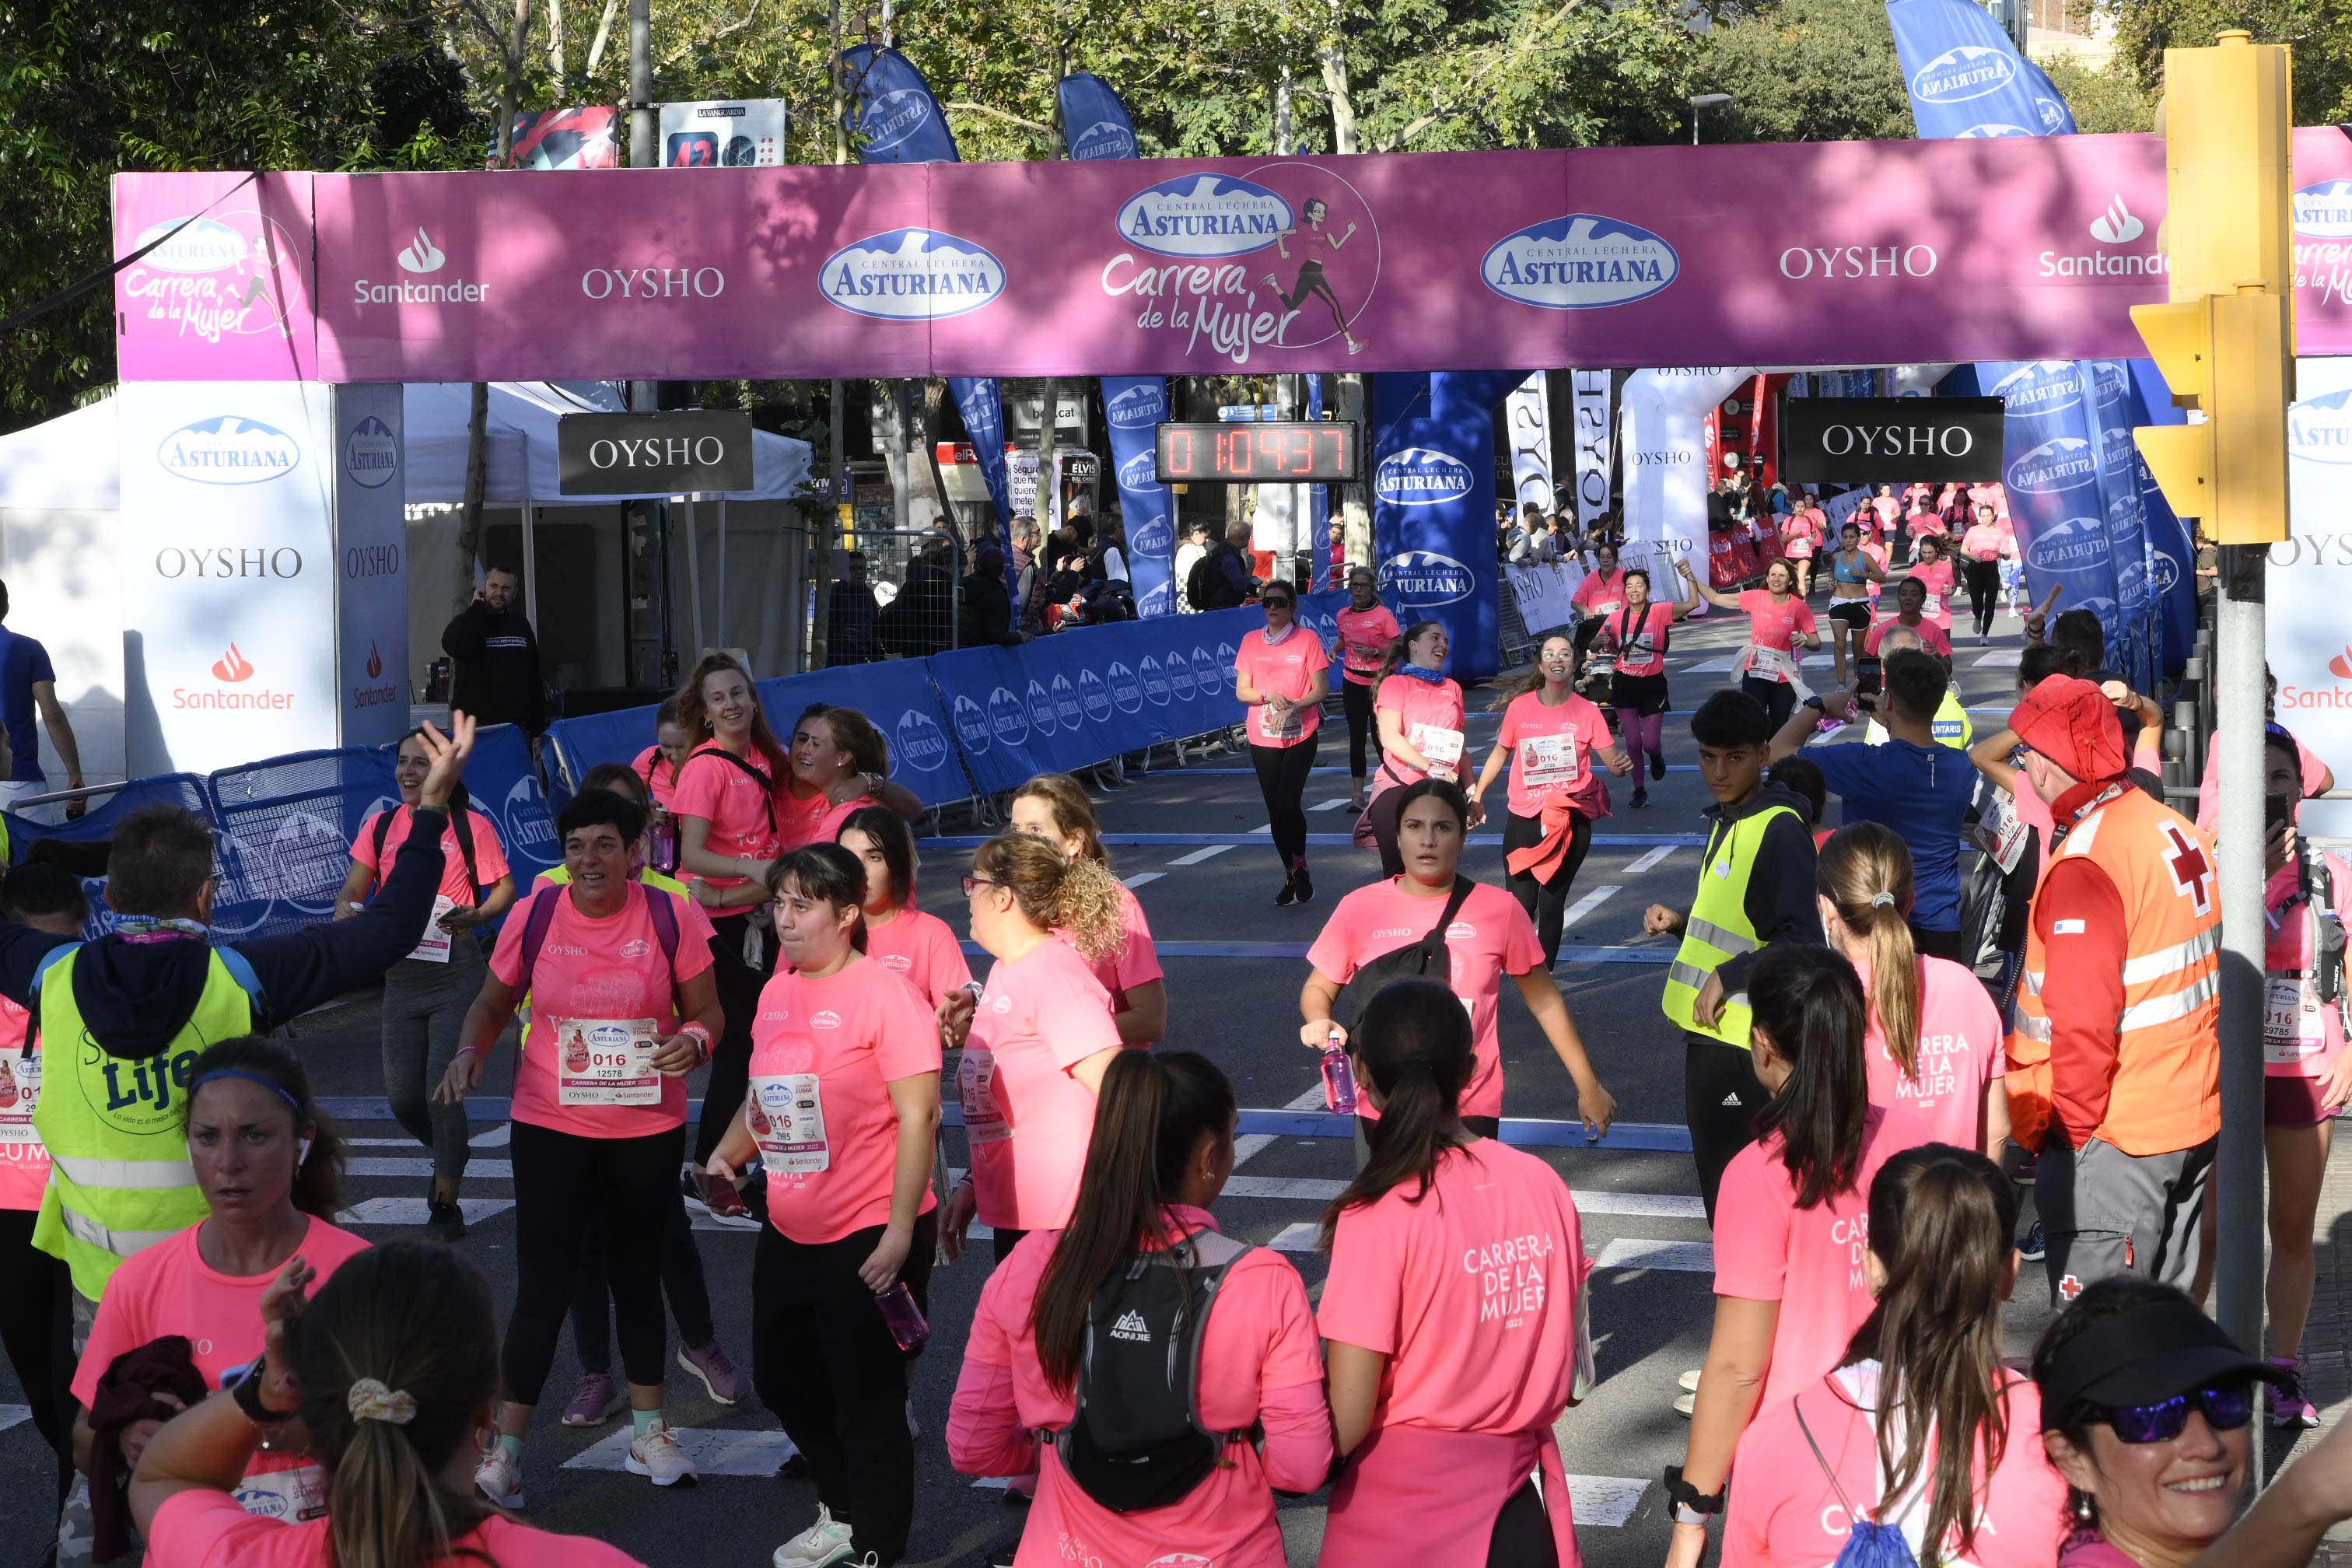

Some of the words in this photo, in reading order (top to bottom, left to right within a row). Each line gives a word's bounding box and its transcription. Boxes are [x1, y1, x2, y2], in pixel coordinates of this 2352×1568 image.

[1157, 201, 1215, 212] CENTRAL
[1218, 201, 1275, 211] LECHERA
[1129, 205, 1279, 238] ASTURIANA
[862, 259, 922, 268] CENTRAL
[925, 258, 985, 268] LECHERA
[1527, 247, 1590, 257] CENTRAL
[1594, 245, 1657, 255] LECHERA
[1779, 243, 1937, 280] OYSHO
[834, 262, 992, 296] ASTURIANA
[1101, 253, 1248, 296] Carrera
[1496, 250, 1664, 285] ASTURIANA
[125, 268, 218, 299] Carrera
[355, 279, 489, 304] Santander
[582, 267, 726, 299] OYSHO
[149, 298, 165, 319] de
[168, 298, 181, 319] la
[179, 294, 253, 343] Mujer
[1137, 299, 1164, 328] de
[1170, 296, 1189, 328] la
[1185, 292, 1302, 364] Mujer
[590, 436, 724, 468] OYSHO
[1822, 425, 1972, 456] OYSHO
[169, 442, 290, 467] ASTURIANA
[349, 447, 395, 471] ASTURIANA
[1632, 451, 1691, 466] OYSHO
[1072, 464, 1096, 473] ELVIS
[1013, 477, 1027, 485] que
[1379, 471, 1467, 492] ASTURIANA
[1015, 507, 1030, 516] este
[155, 547, 303, 578] OYSHO
[346, 544, 399, 578] OYSHO
[173, 688, 296, 709] Santander
[354, 685, 397, 709] Santander
[901, 735, 945, 758] ASTURIANA
[1540, 754, 1558, 762] 016
[1998, 814, 2014, 836] 016
[1373, 928, 1412, 940] OYSHO
[547, 943, 588, 957] OYSHO
[591, 1033, 628, 1042] ASTURIANA
[593, 1054, 627, 1066] 016
[1929, 1057, 1953, 1076] LA
[102, 1044, 199, 1111] Life
[1895, 1076, 1955, 1100] MUJER
[769, 1115, 792, 1129] 016
[1463, 1231, 1555, 1274] CARRERA
[1484, 1268, 1510, 1296] DE
[1516, 1265, 1544, 1288] LA
[1109, 1328, 1151, 1342] AONIJIE
